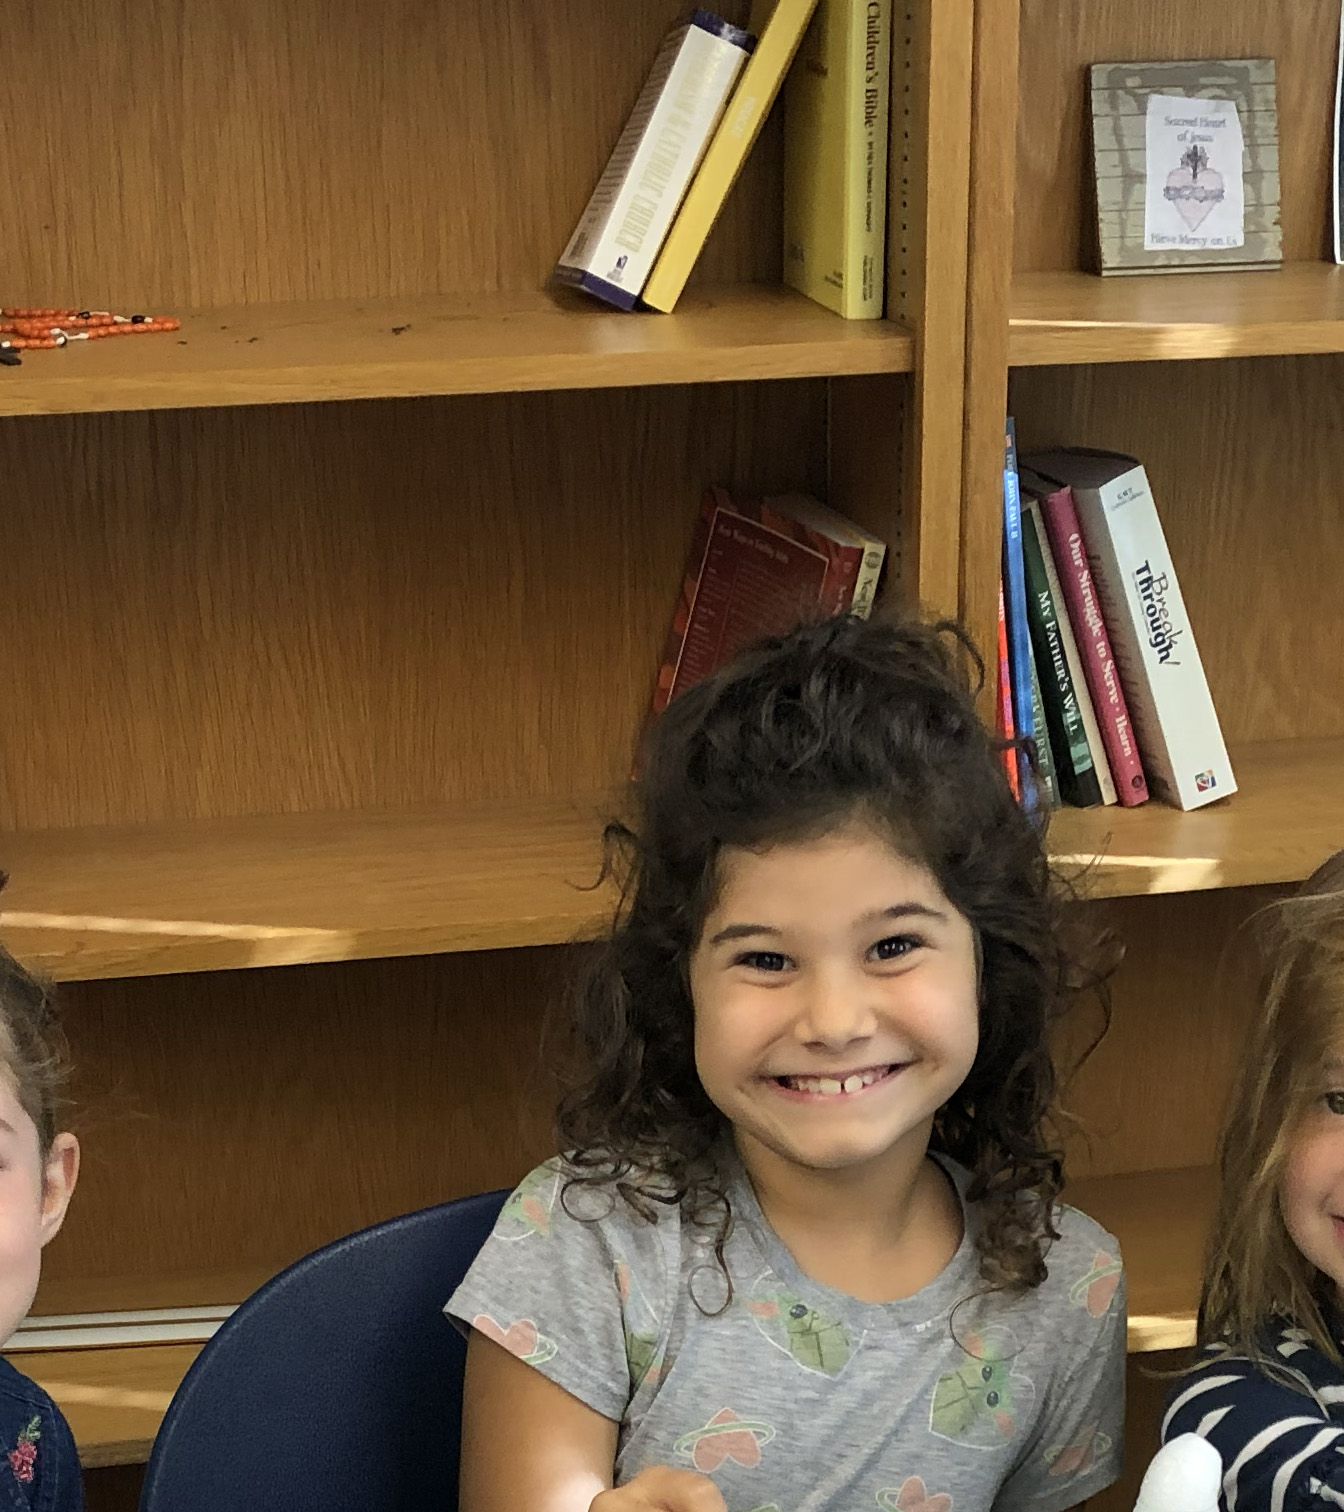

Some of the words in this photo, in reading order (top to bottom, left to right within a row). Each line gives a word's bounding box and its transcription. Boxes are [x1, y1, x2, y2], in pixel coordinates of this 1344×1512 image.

[865, 2, 881, 84] Children's
[864, 88, 878, 129] Bible
[1177, 130, 1190, 141] of
[1007, 480, 1016, 505] JOHN
[1152, 572, 1183, 645] Break
[1068, 533, 1084, 567] Our
[1077, 569, 1105, 637] Struggle
[1096, 641, 1107, 657] to
[1102, 659, 1119, 704] Serve
[1115, 713, 1132, 756] Hearn
